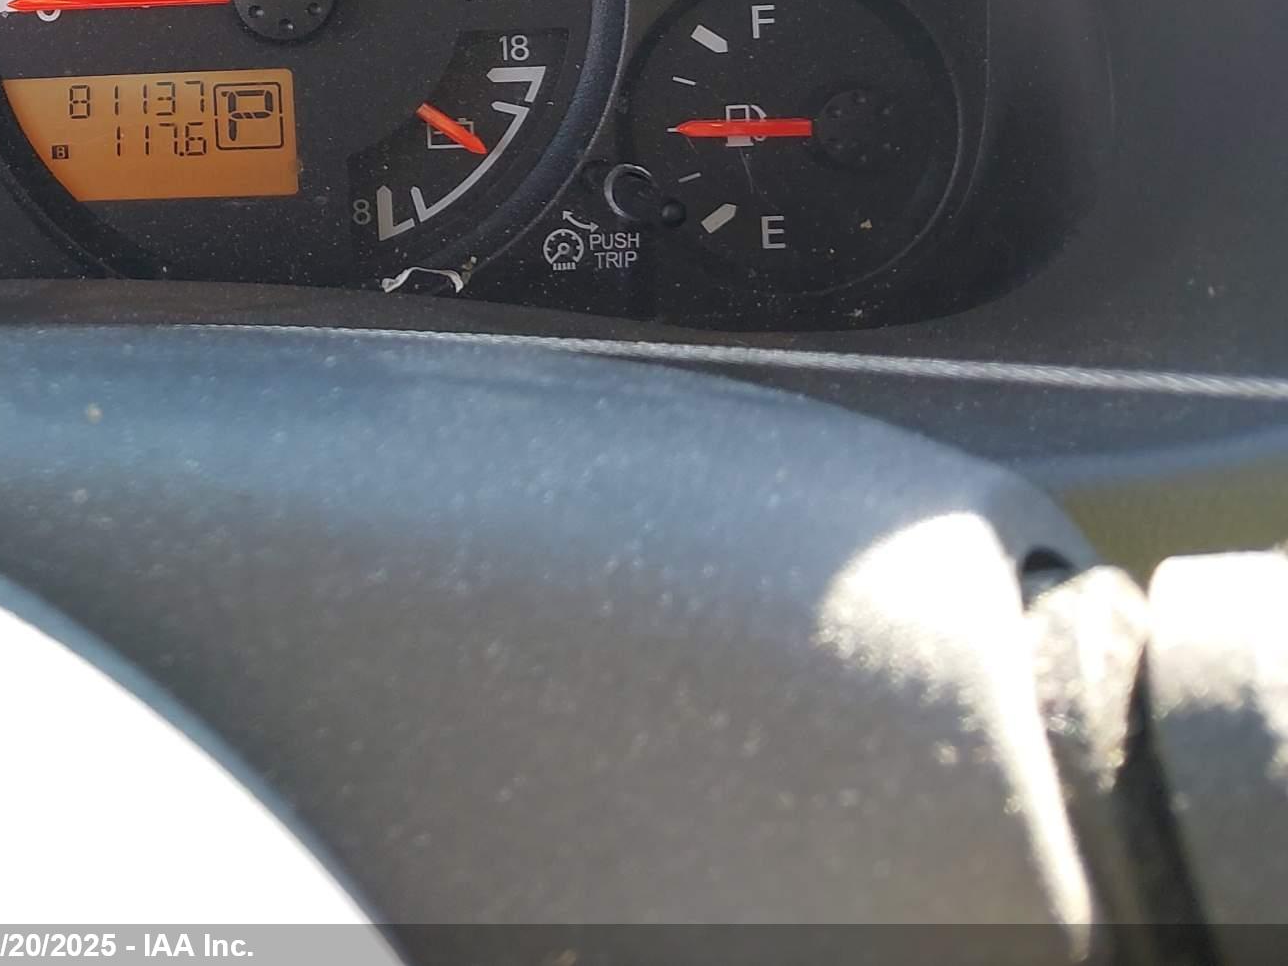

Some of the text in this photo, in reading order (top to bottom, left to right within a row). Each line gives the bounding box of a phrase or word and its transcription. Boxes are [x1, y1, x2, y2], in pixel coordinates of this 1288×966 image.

[751, 4, 775, 39] F
[499, 34, 530, 61] 18
[69, 81, 204, 119] 81137
[221, 90, 274, 141] P
[116, 122, 207, 156] 117.6
[353, 198, 371, 225] 8
[589, 232, 641, 251] PUSH
[761, 215, 786, 249] E
[593, 250, 638, 269] TRIP
